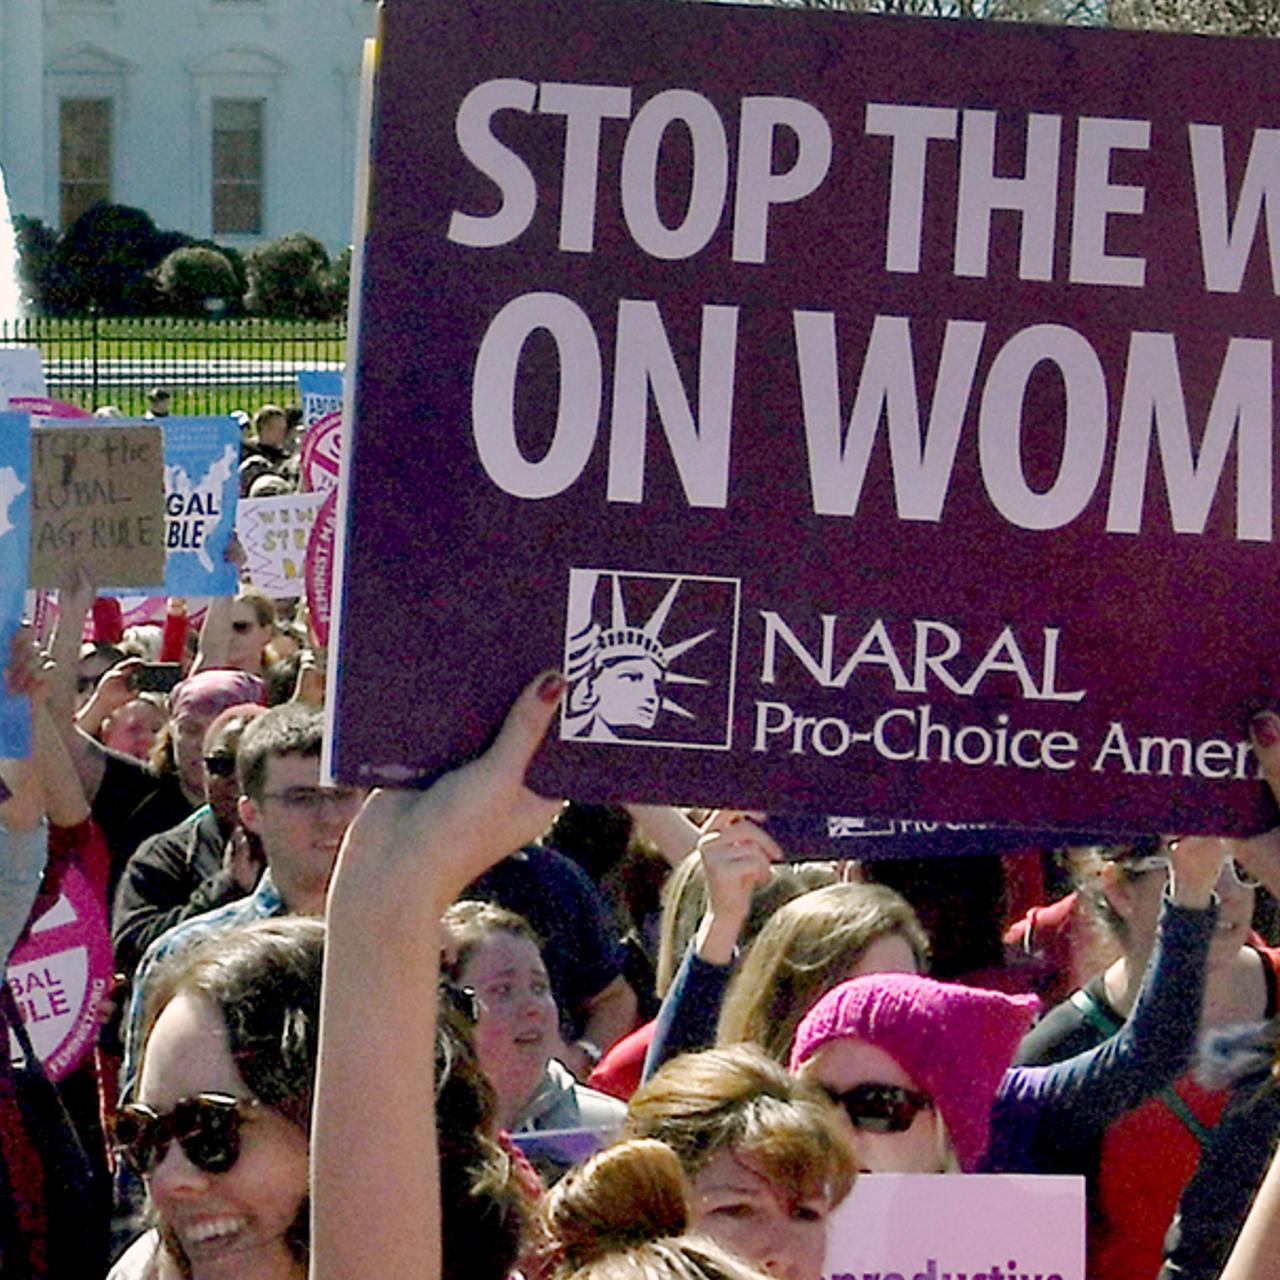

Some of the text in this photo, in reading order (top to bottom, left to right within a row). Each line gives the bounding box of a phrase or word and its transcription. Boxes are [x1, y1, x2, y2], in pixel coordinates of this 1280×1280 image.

[447, 78, 833, 265] STOP
[864, 101, 1151, 288] THE
[471, 291, 1274, 542] ON WOM
[757, 611, 1087, 704] NARAL
[753, 698, 1080, 771] Pro-Choice
